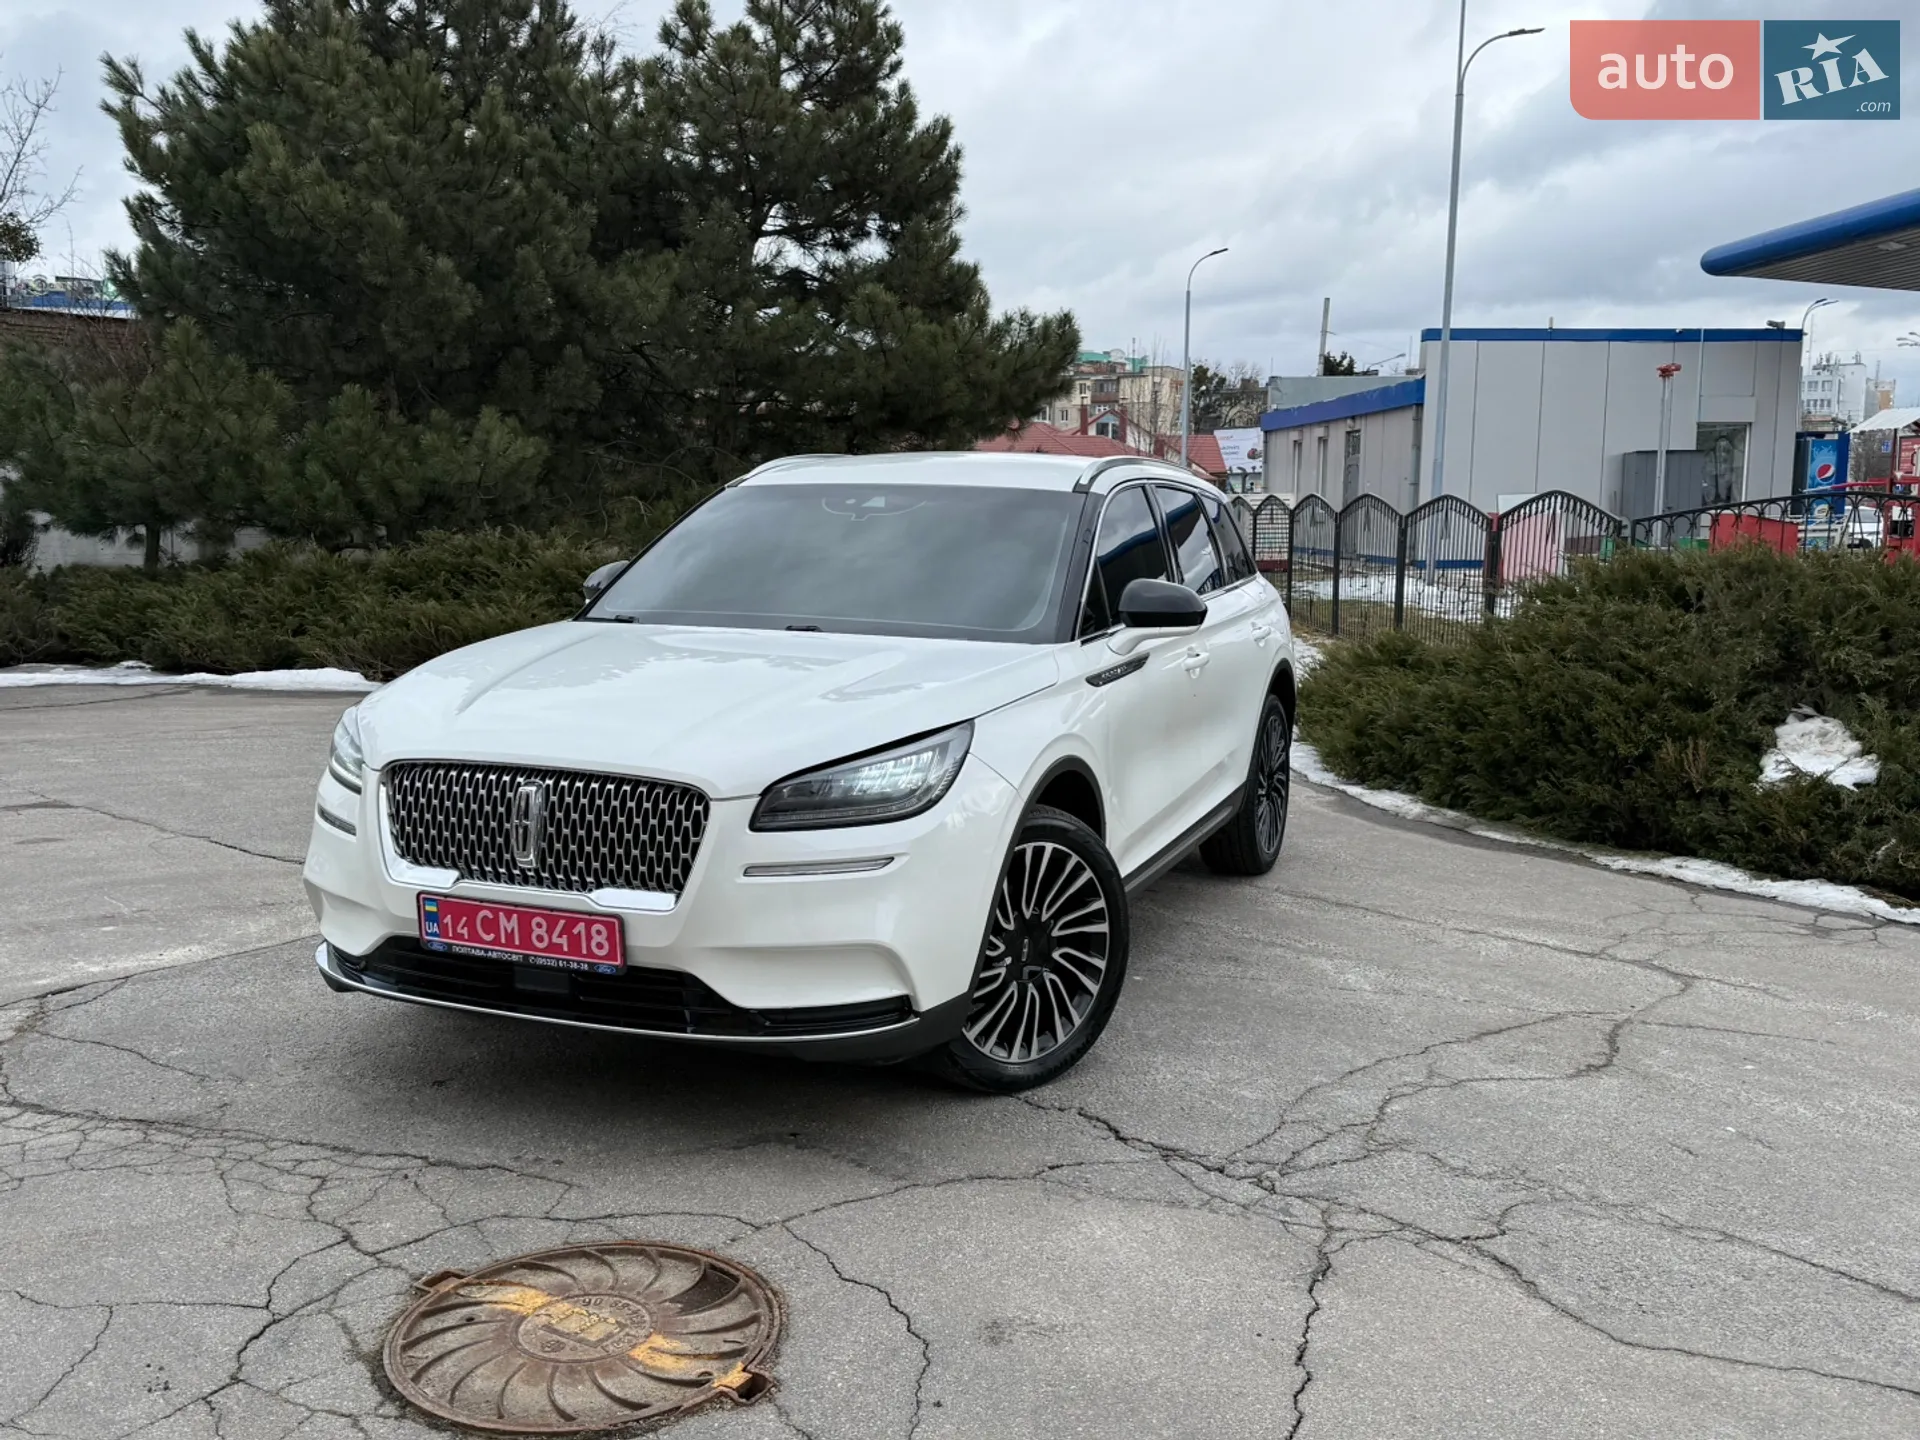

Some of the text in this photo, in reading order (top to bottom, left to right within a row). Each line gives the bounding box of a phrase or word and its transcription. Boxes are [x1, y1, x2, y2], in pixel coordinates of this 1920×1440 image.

[425, 921, 440, 935] UA
[443, 914, 469, 940] 14
[531, 916, 609, 956] 8418
